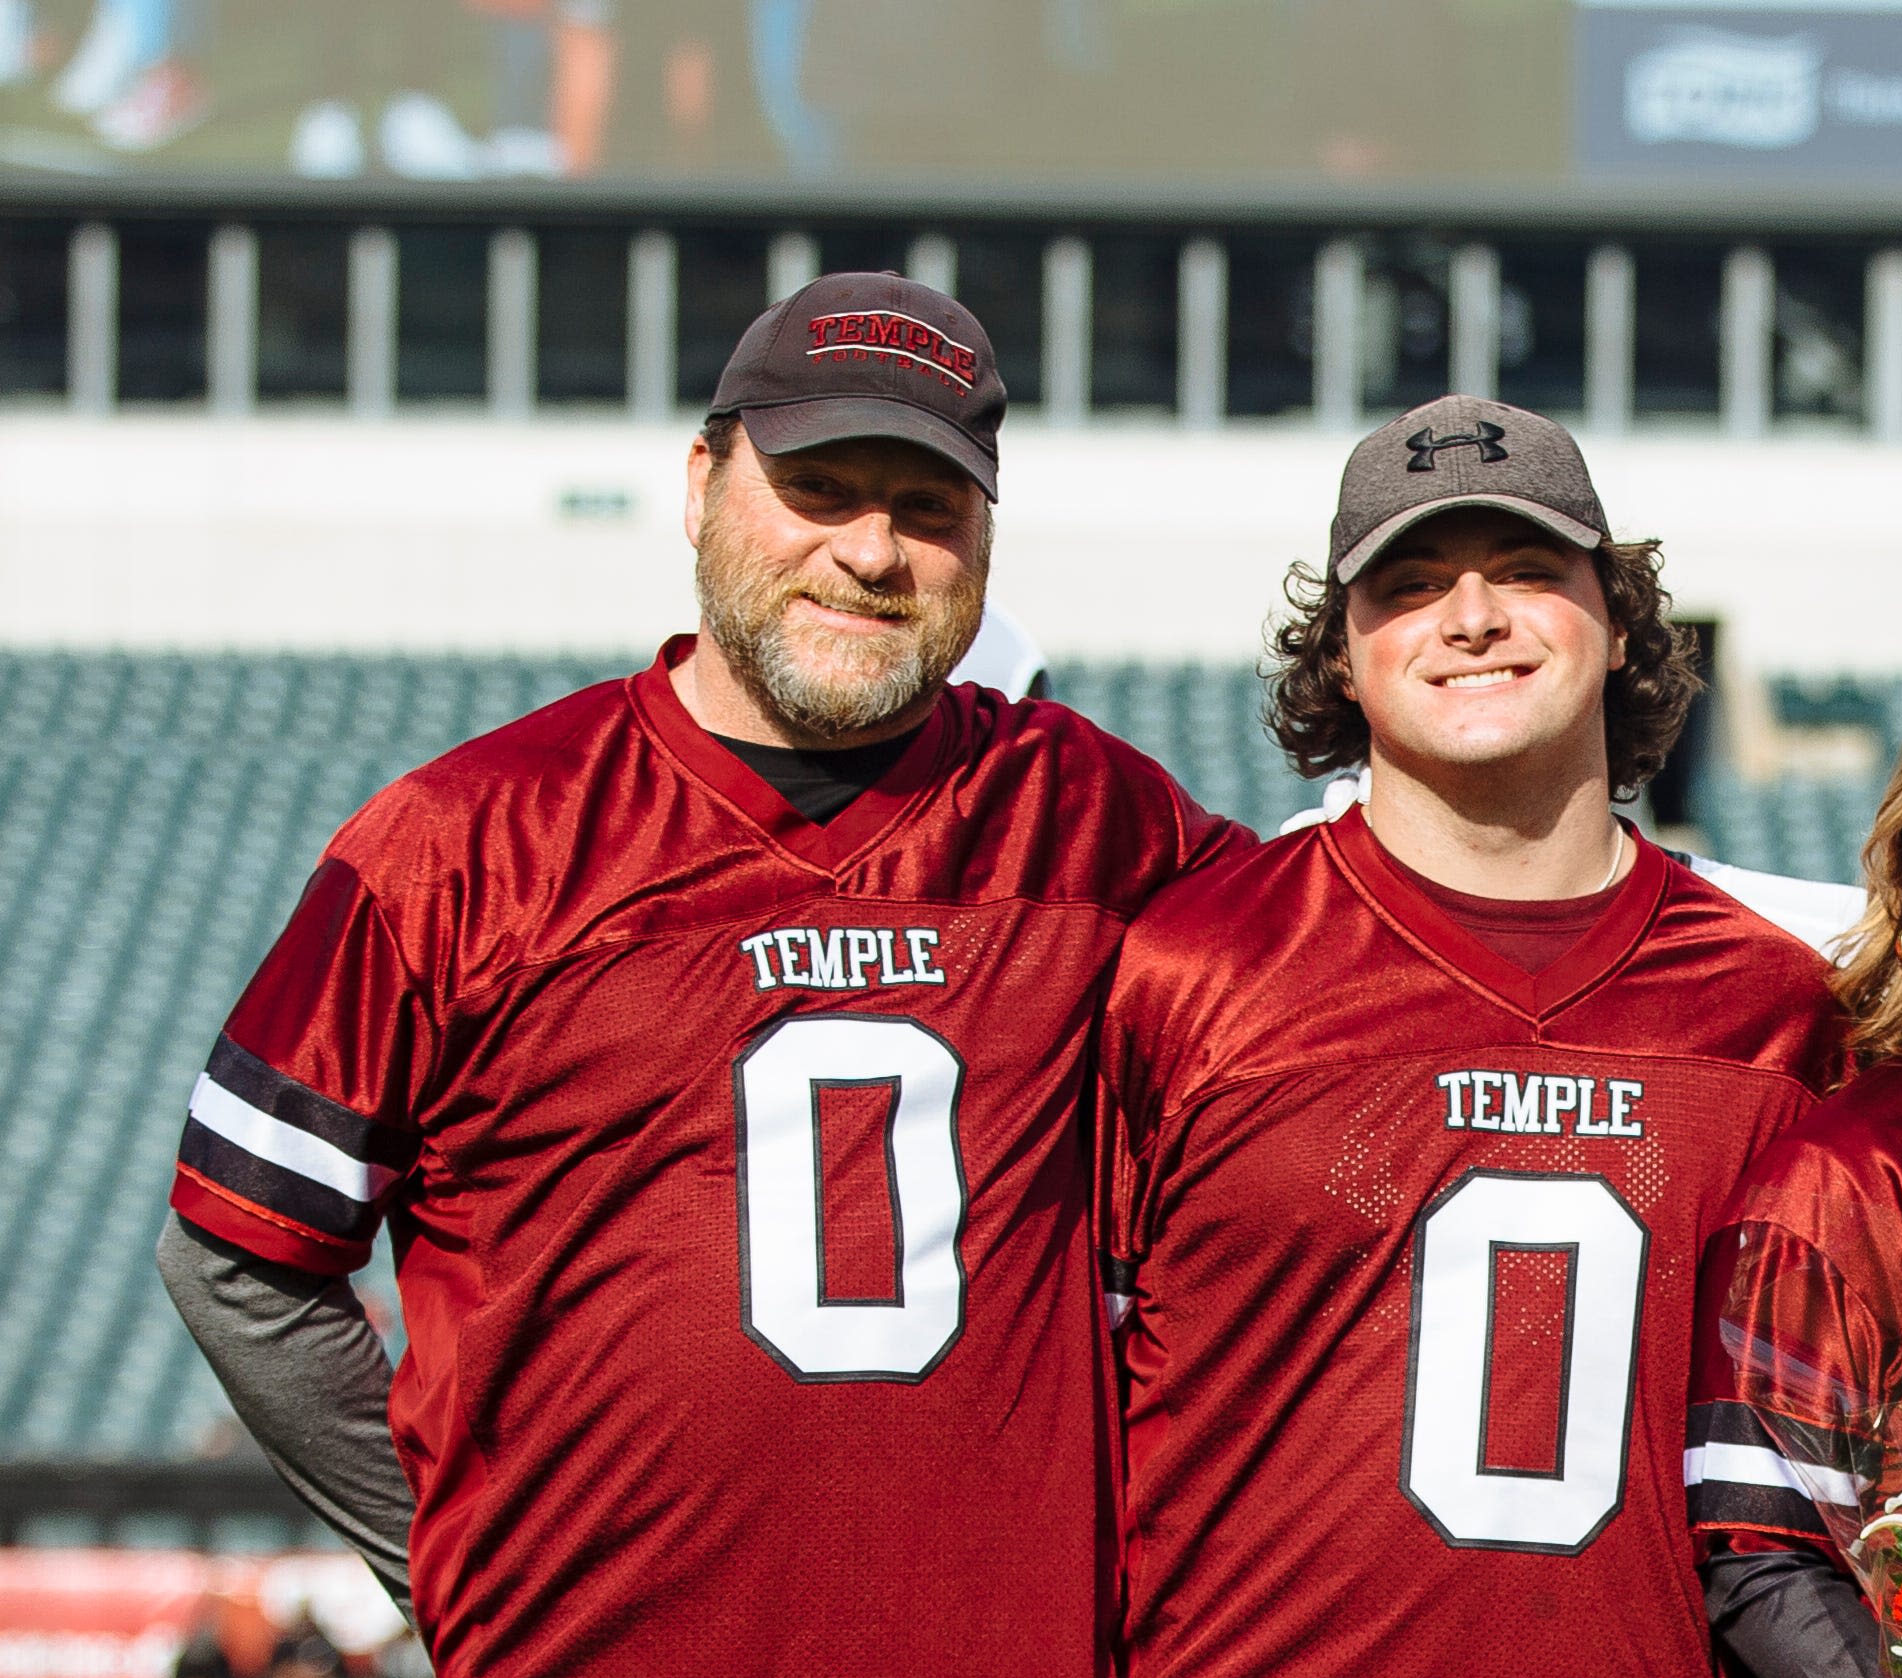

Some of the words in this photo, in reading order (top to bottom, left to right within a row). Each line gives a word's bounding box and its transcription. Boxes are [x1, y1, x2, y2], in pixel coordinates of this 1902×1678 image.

[808, 314, 976, 385] TEMPLE
[811, 349, 968, 398] FOOTBALL
[741, 928, 947, 989] TEMPLE
[1437, 1069, 1645, 1137] TEMPLE
[733, 1013, 968, 1384] 0
[1399, 1166, 1652, 1556] 0
